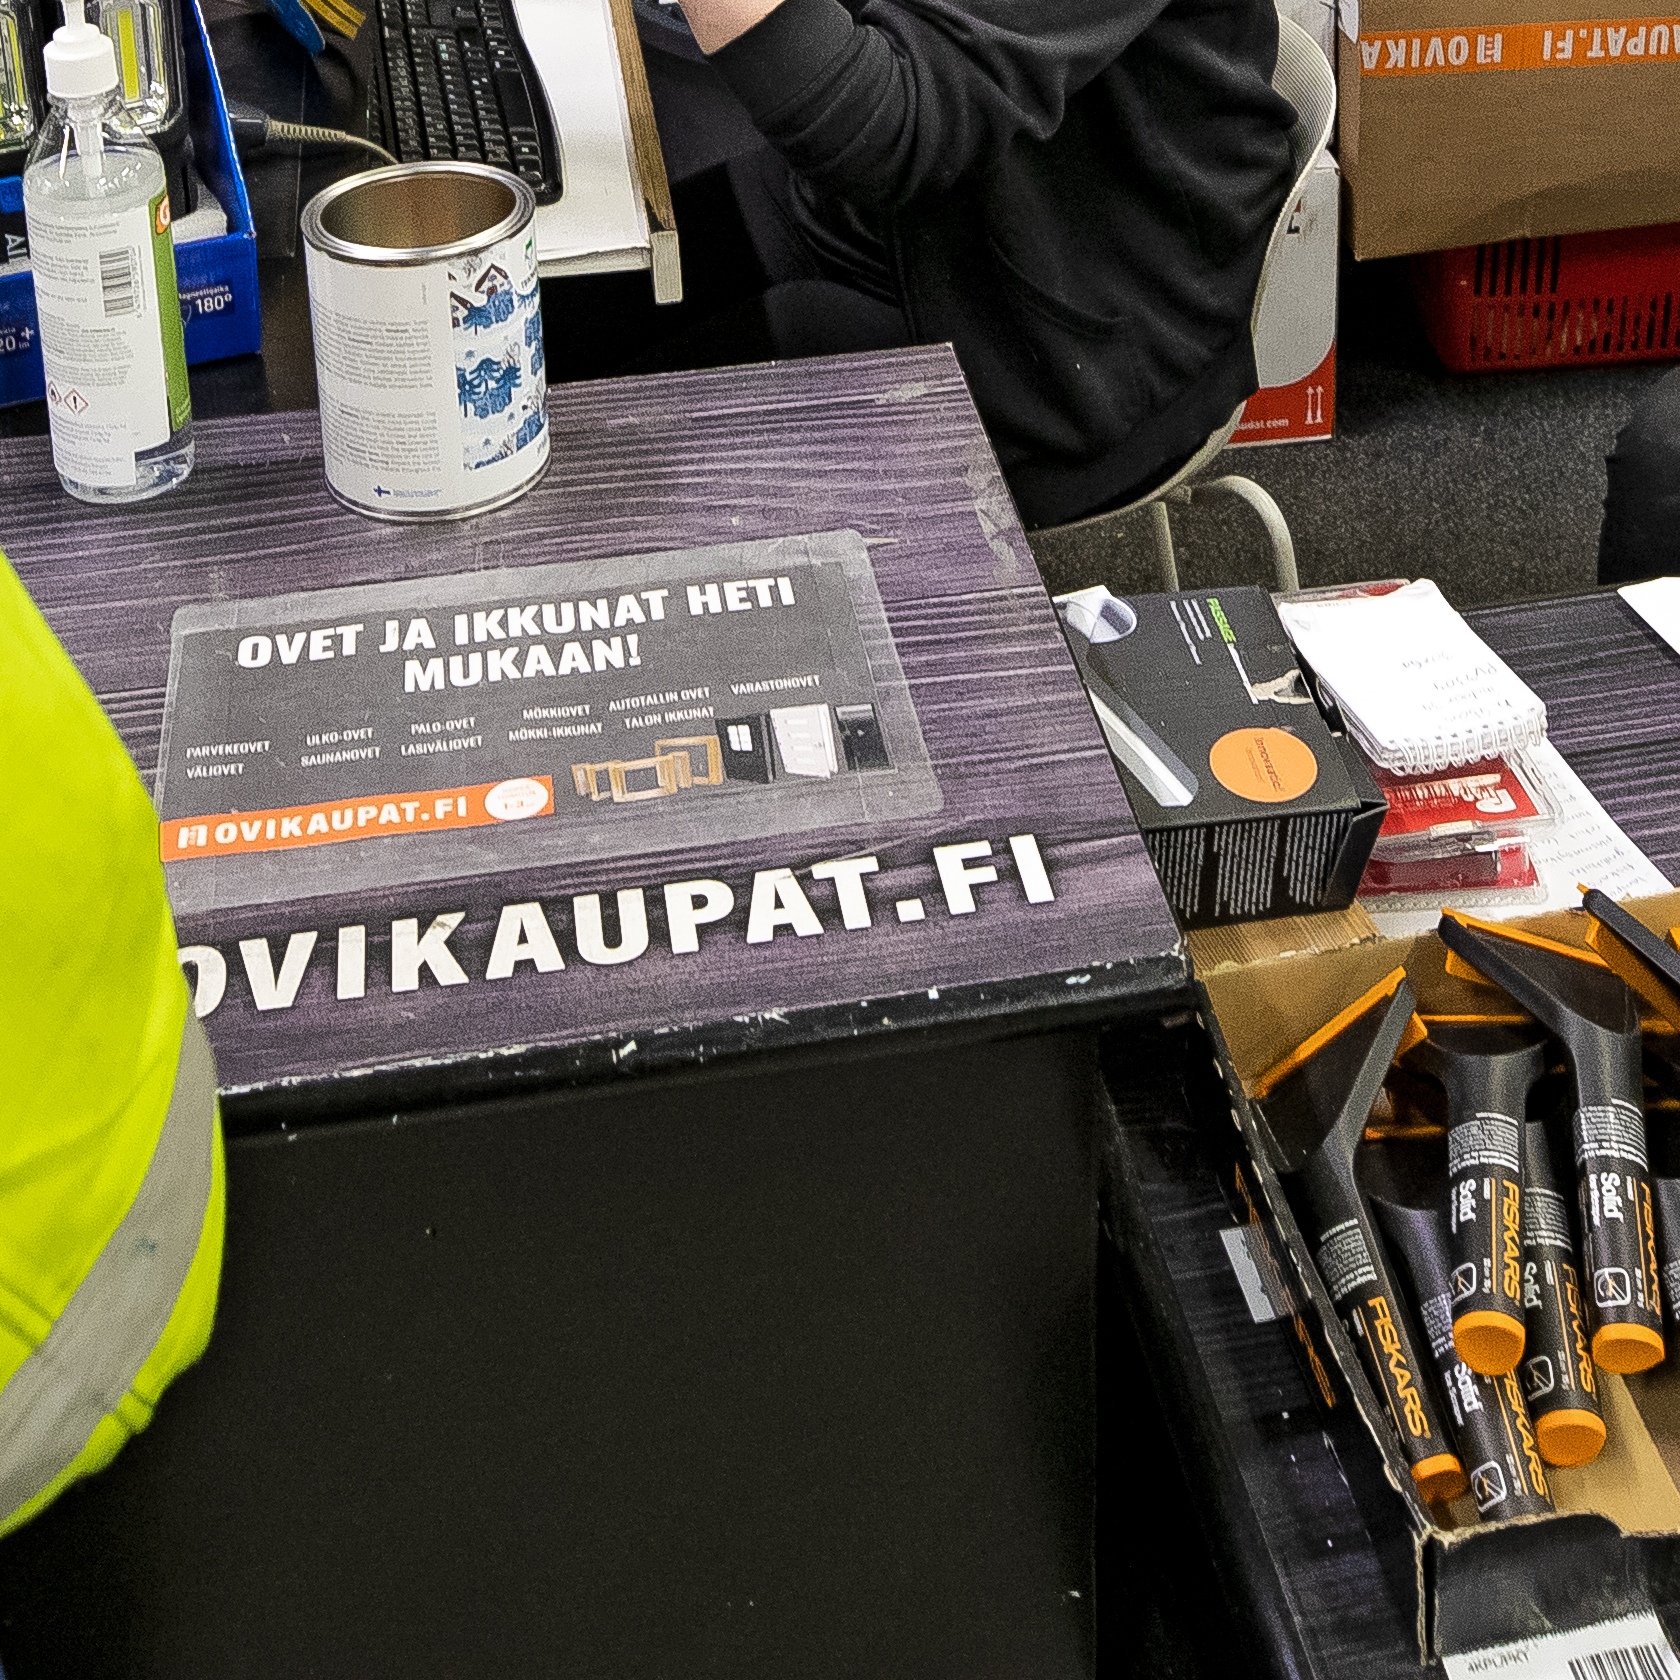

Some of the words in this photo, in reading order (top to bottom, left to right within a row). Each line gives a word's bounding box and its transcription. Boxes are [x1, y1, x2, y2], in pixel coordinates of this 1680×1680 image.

[235, 623, 365, 670] OVET
[377, 617, 437, 653] JA
[452, 588, 669, 646] IKKUNAT
[686, 574, 795, 612] HETI
[401, 633, 643, 694] MUKAAN!
[730, 674, 821, 695] VARASTONOVET
[609, 692, 679, 712] AUTOTALLIN
[680, 686, 711, 702] OVET
[522, 703, 591, 721] MÖKKIOVET
[624, 713, 663, 730] TALON
[665, 705, 715, 725] IKKUNAT
[306, 726, 374, 747] ULKO-OVET
[410, 717, 476, 736] PALO-OVET
[508, 722, 603, 742] MÖKKI-IKKUNAT
[186, 740, 271, 760] PARVEKEOVET
[300, 746, 381, 768] SAUNANOVET
[400, 735, 483, 757] LASIVÄLIOVET
[186, 762, 245, 780] VÄLIOVET
[1457, 1175, 1478, 1225] Solid
[1599, 1171, 1625, 1223] Solid
[1366, 1294, 1431, 1439] FISKARS
